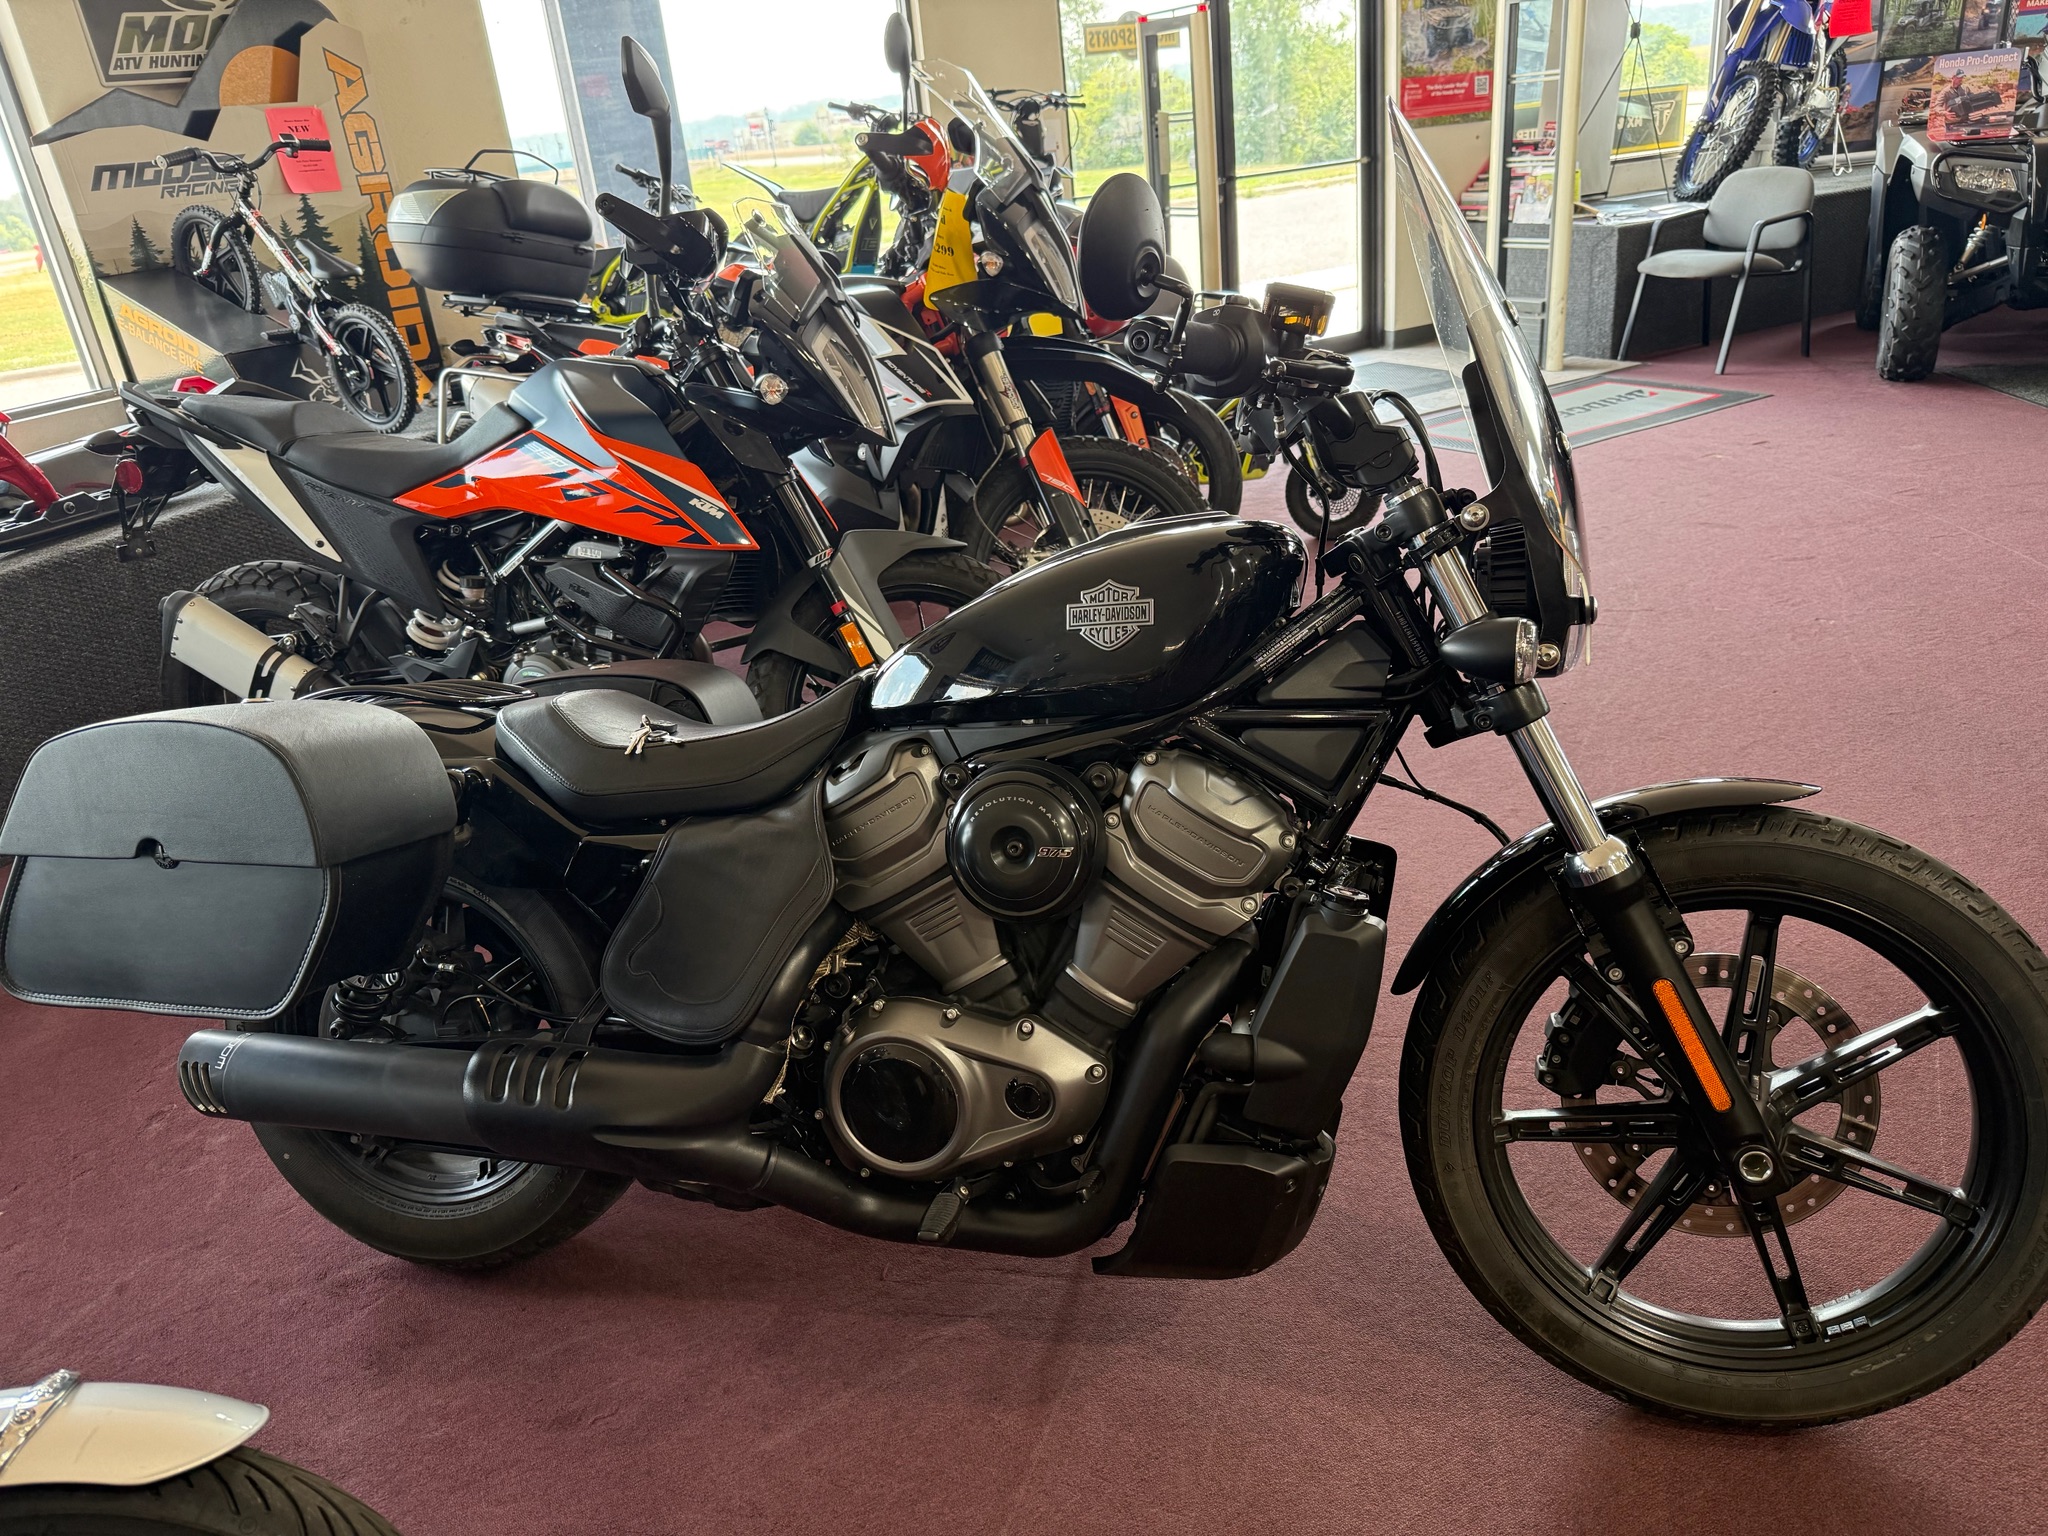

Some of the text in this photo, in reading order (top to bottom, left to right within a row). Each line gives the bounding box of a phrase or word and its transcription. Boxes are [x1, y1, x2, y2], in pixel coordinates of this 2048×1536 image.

[113, 56, 143, 71] ATV
[1940, 51, 2018, 69] Honda Pro-Connect
[287, 125, 311, 133] NEW
[322, 47, 432, 362] AGROID
[119, 303, 200, 358] AGROID
[118, 316, 205, 375] E-BALANCE BIKE
[883, 359, 926, 395] ADVENTURE
[1040, 472, 1076, 494] 790
[688, 497, 725, 520] KTM
[1089, 586, 1130, 604] MOTOR
[1072, 604, 1148, 625] HARLEY-DAVIDSON
[1089, 625, 1129, 645] CYCLES
[969, 796, 1058, 827] REVOLUTION MAX
[1147, 804, 1245, 867] HARLEY-DAVIDSON
[1037, 846, 1074, 858] 975
[1438, 970, 1495, 1148] DUNLOP D401F
